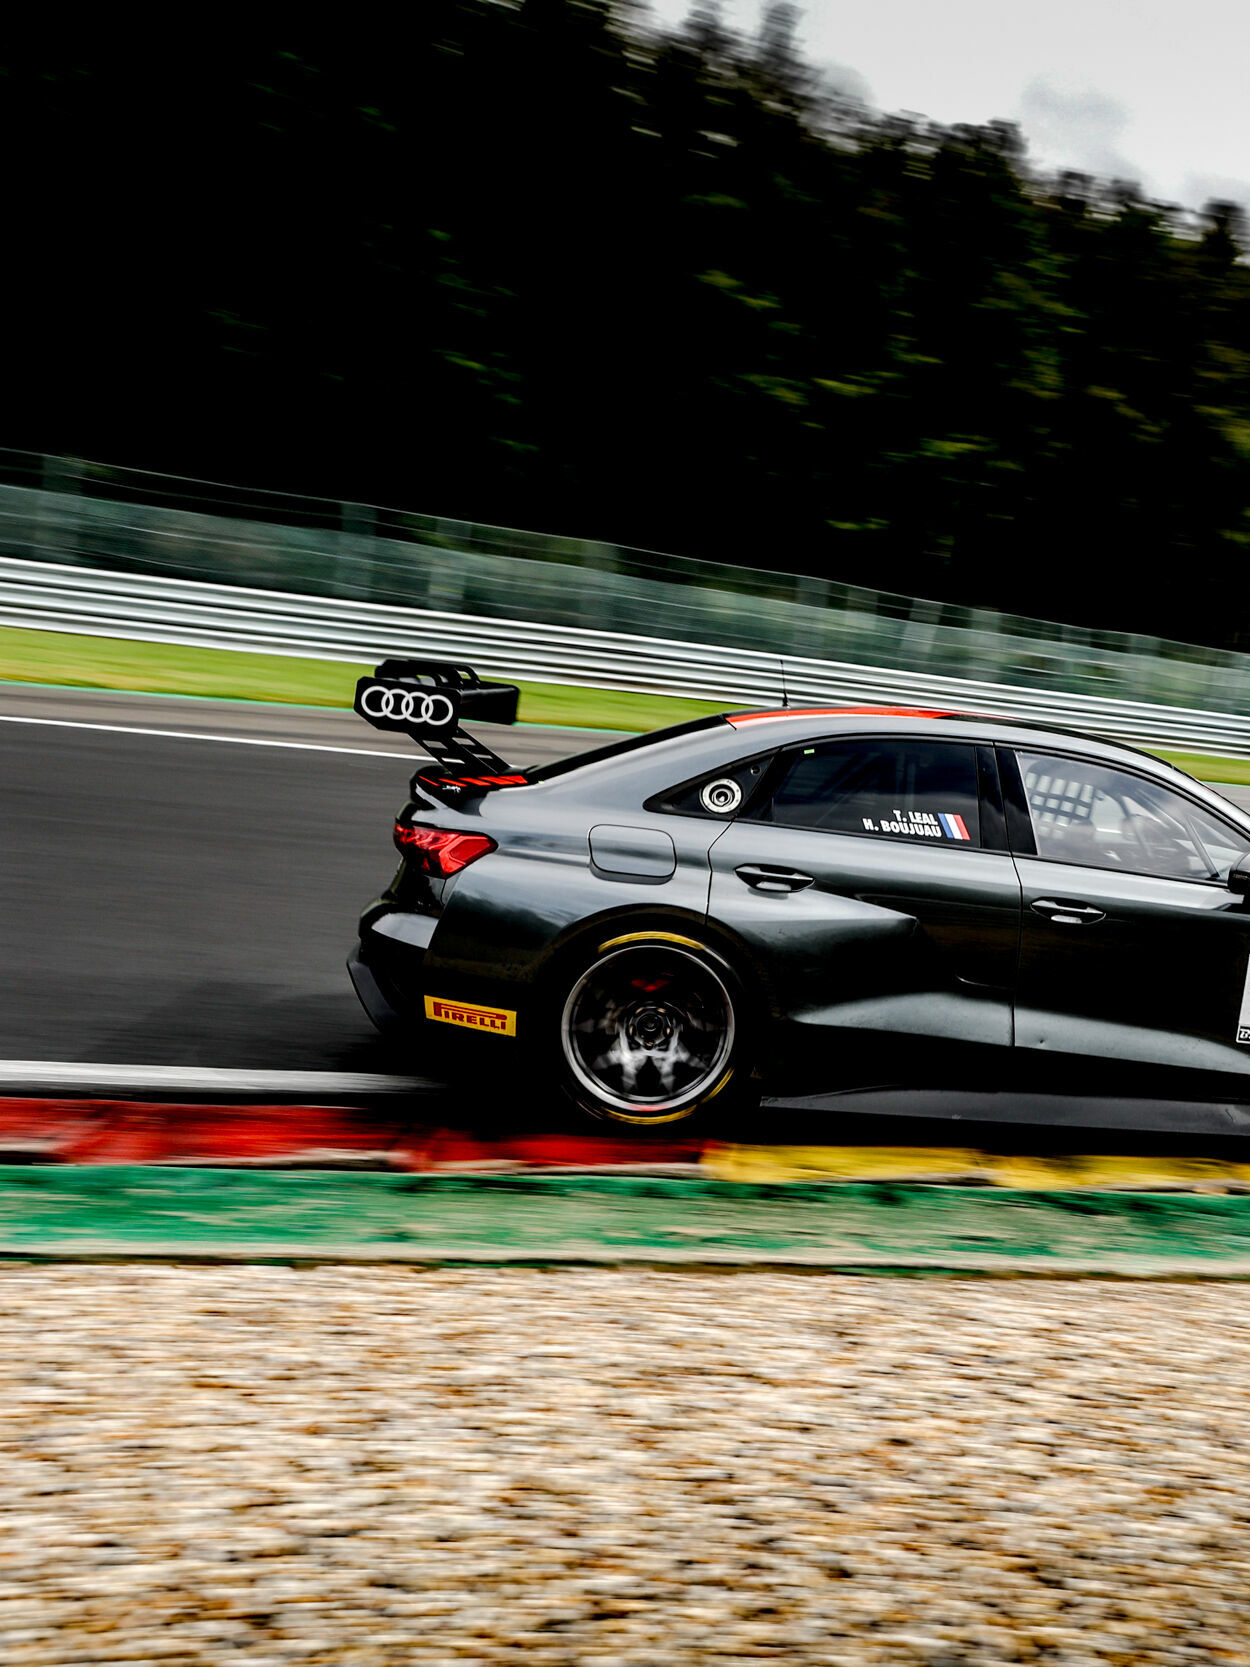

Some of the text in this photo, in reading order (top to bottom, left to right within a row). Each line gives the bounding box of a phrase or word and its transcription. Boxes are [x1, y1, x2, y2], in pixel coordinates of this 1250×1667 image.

[893, 809, 938, 825] T. LEAL
[862, 818, 942, 838] H. BOUJUAU
[433, 1001, 508, 1031] PIRELLI
